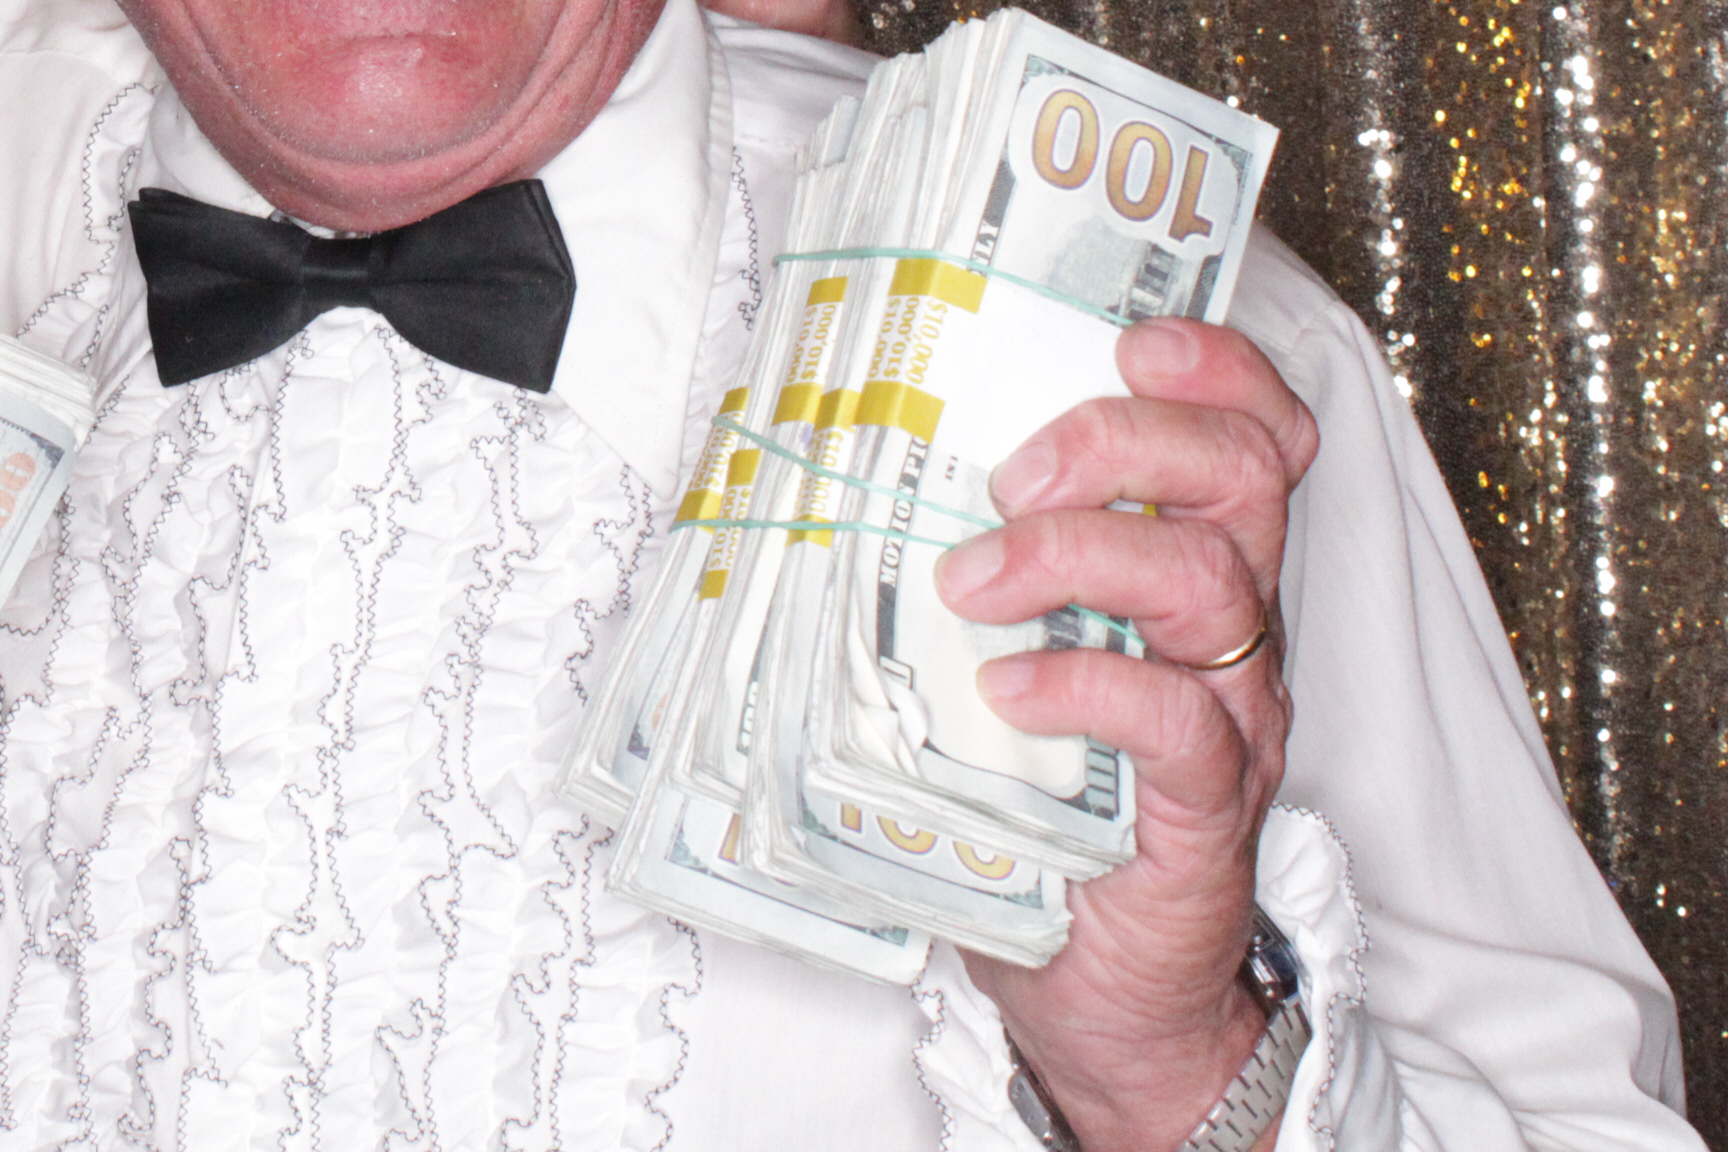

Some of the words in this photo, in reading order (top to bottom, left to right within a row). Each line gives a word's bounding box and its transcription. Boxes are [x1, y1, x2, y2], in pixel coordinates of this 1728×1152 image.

[1031, 88, 1214, 243] 100
[801, 305, 836, 380] $10,000
[883, 297, 920, 378] $10,000
[906, 299, 948, 385] $10,000
